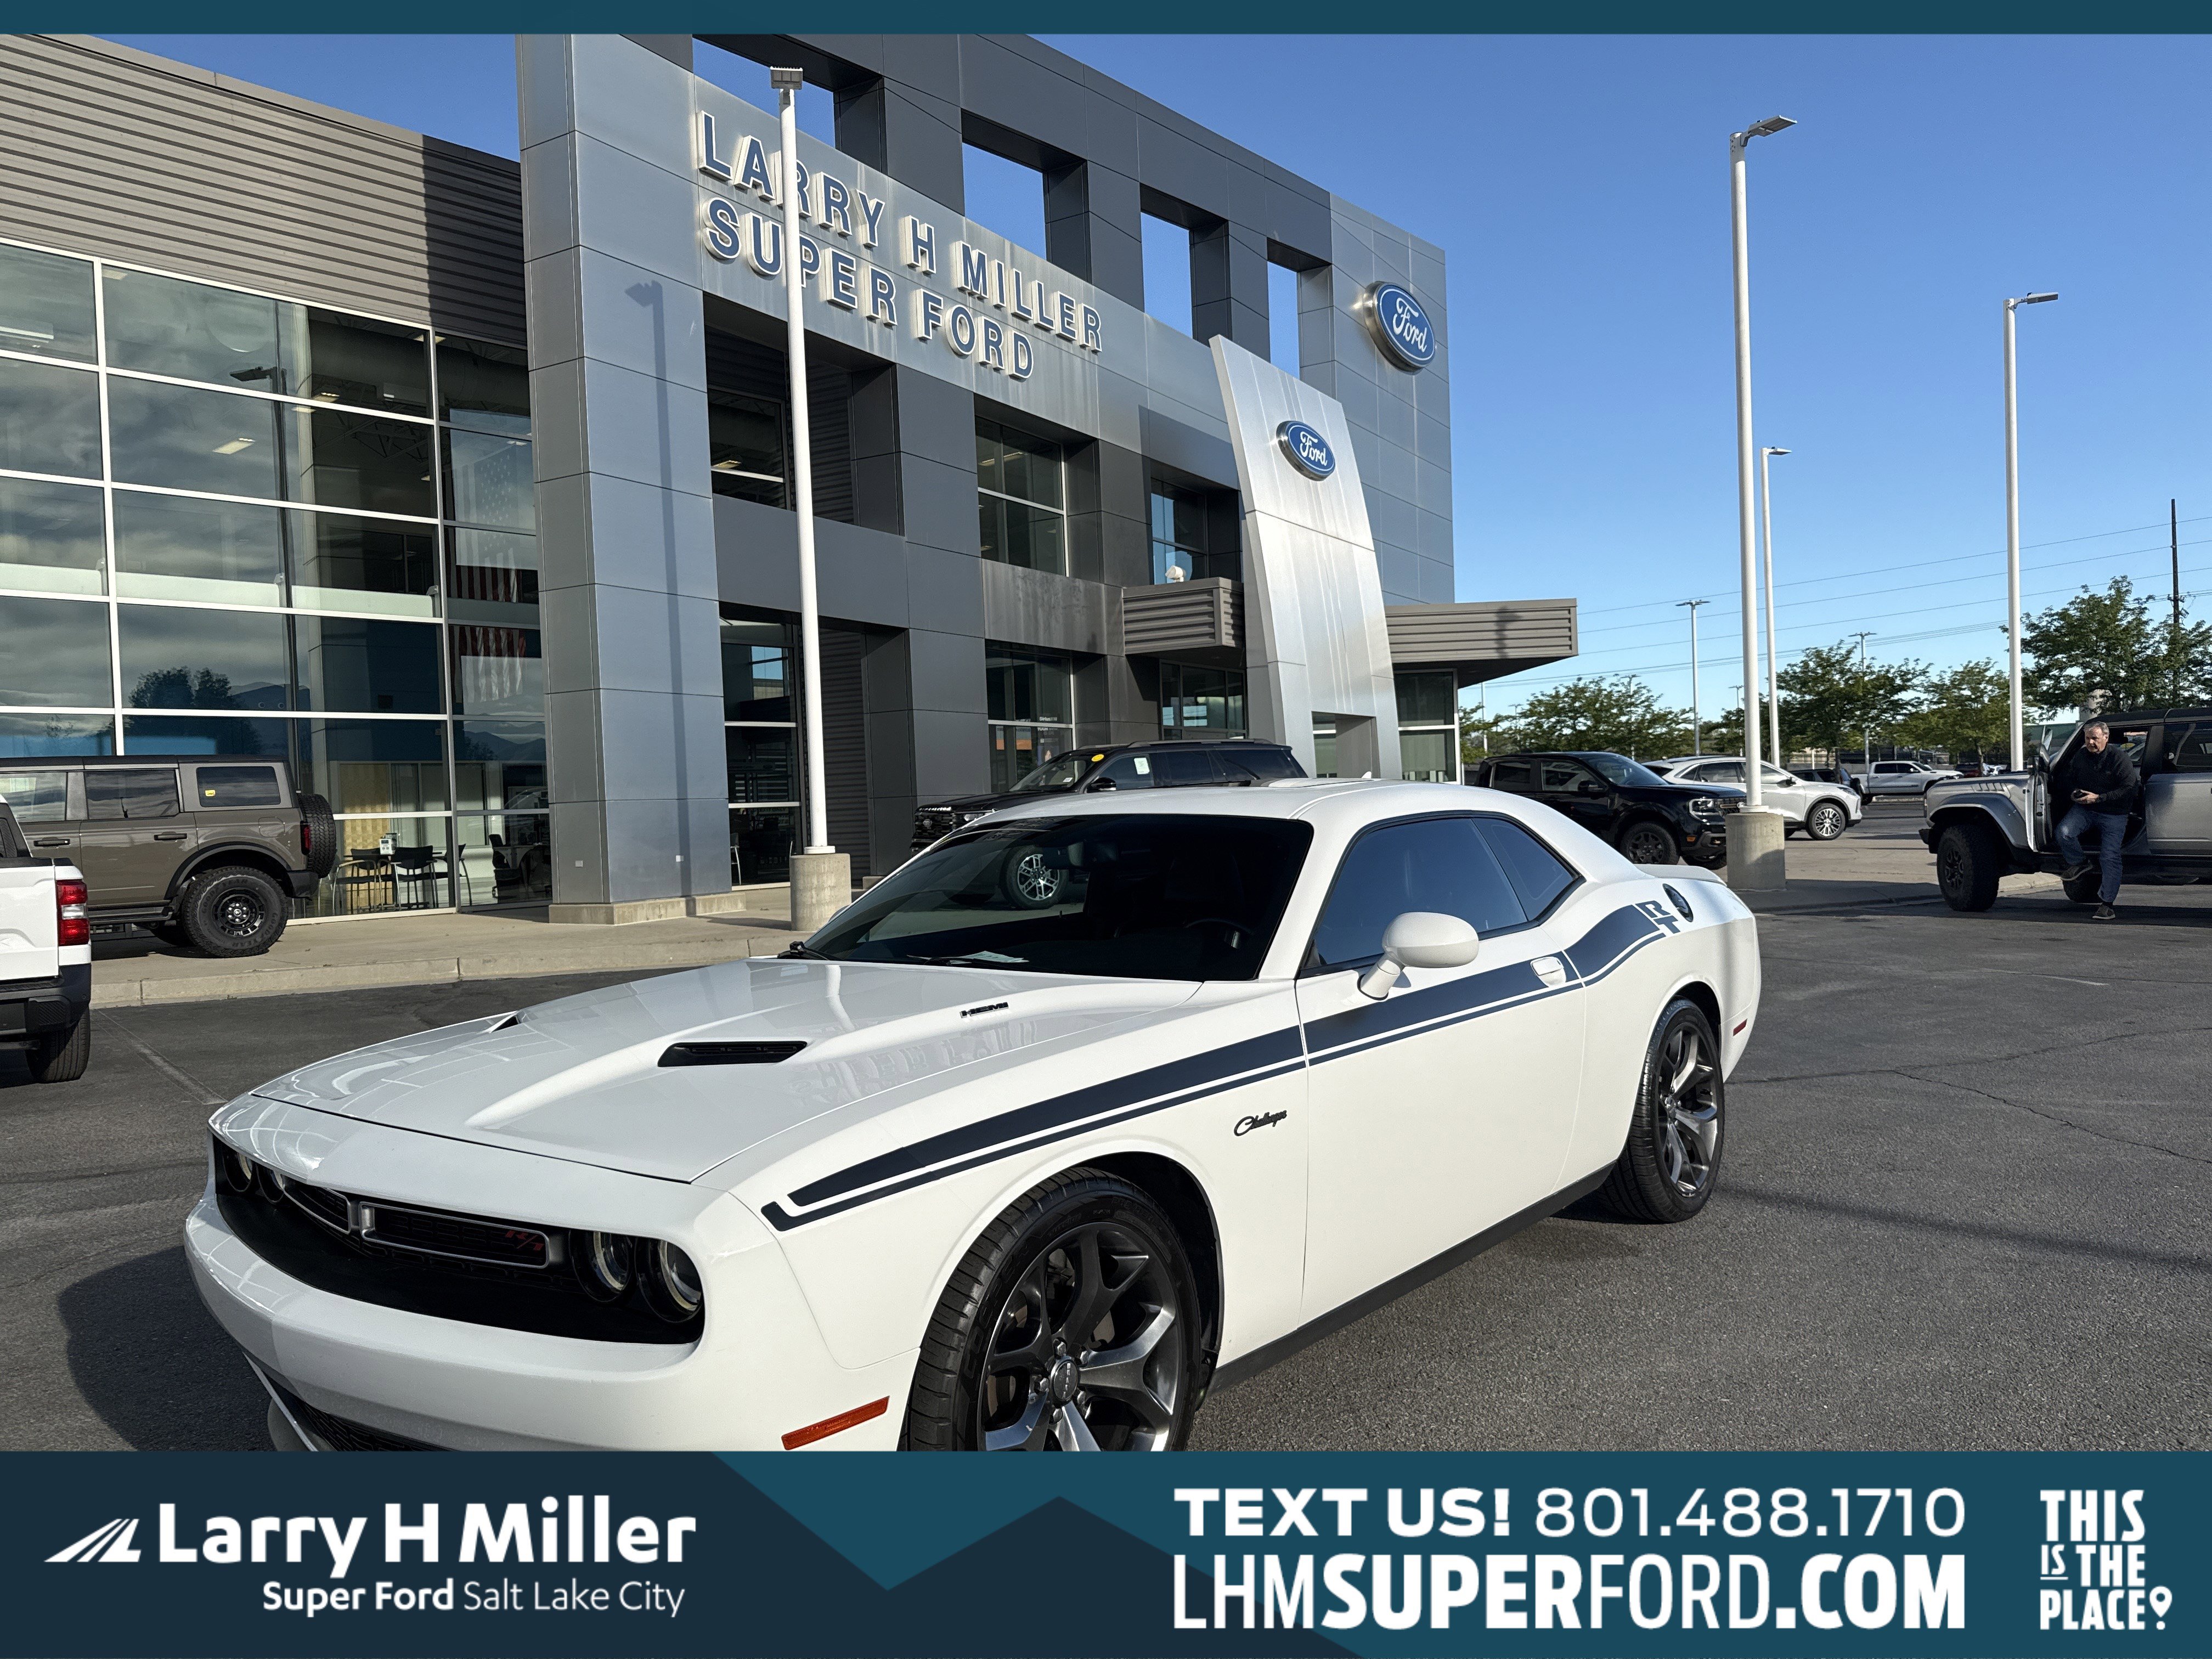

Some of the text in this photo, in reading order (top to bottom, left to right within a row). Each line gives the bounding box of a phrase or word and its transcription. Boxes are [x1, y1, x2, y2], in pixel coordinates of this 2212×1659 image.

[905, 215, 936, 274] H
[955, 240, 1103, 353] MILLER
[916, 288, 1034, 380] FORD
[1392, 297, 1427, 353] Ford
[1300, 431, 1328, 466] Ford
